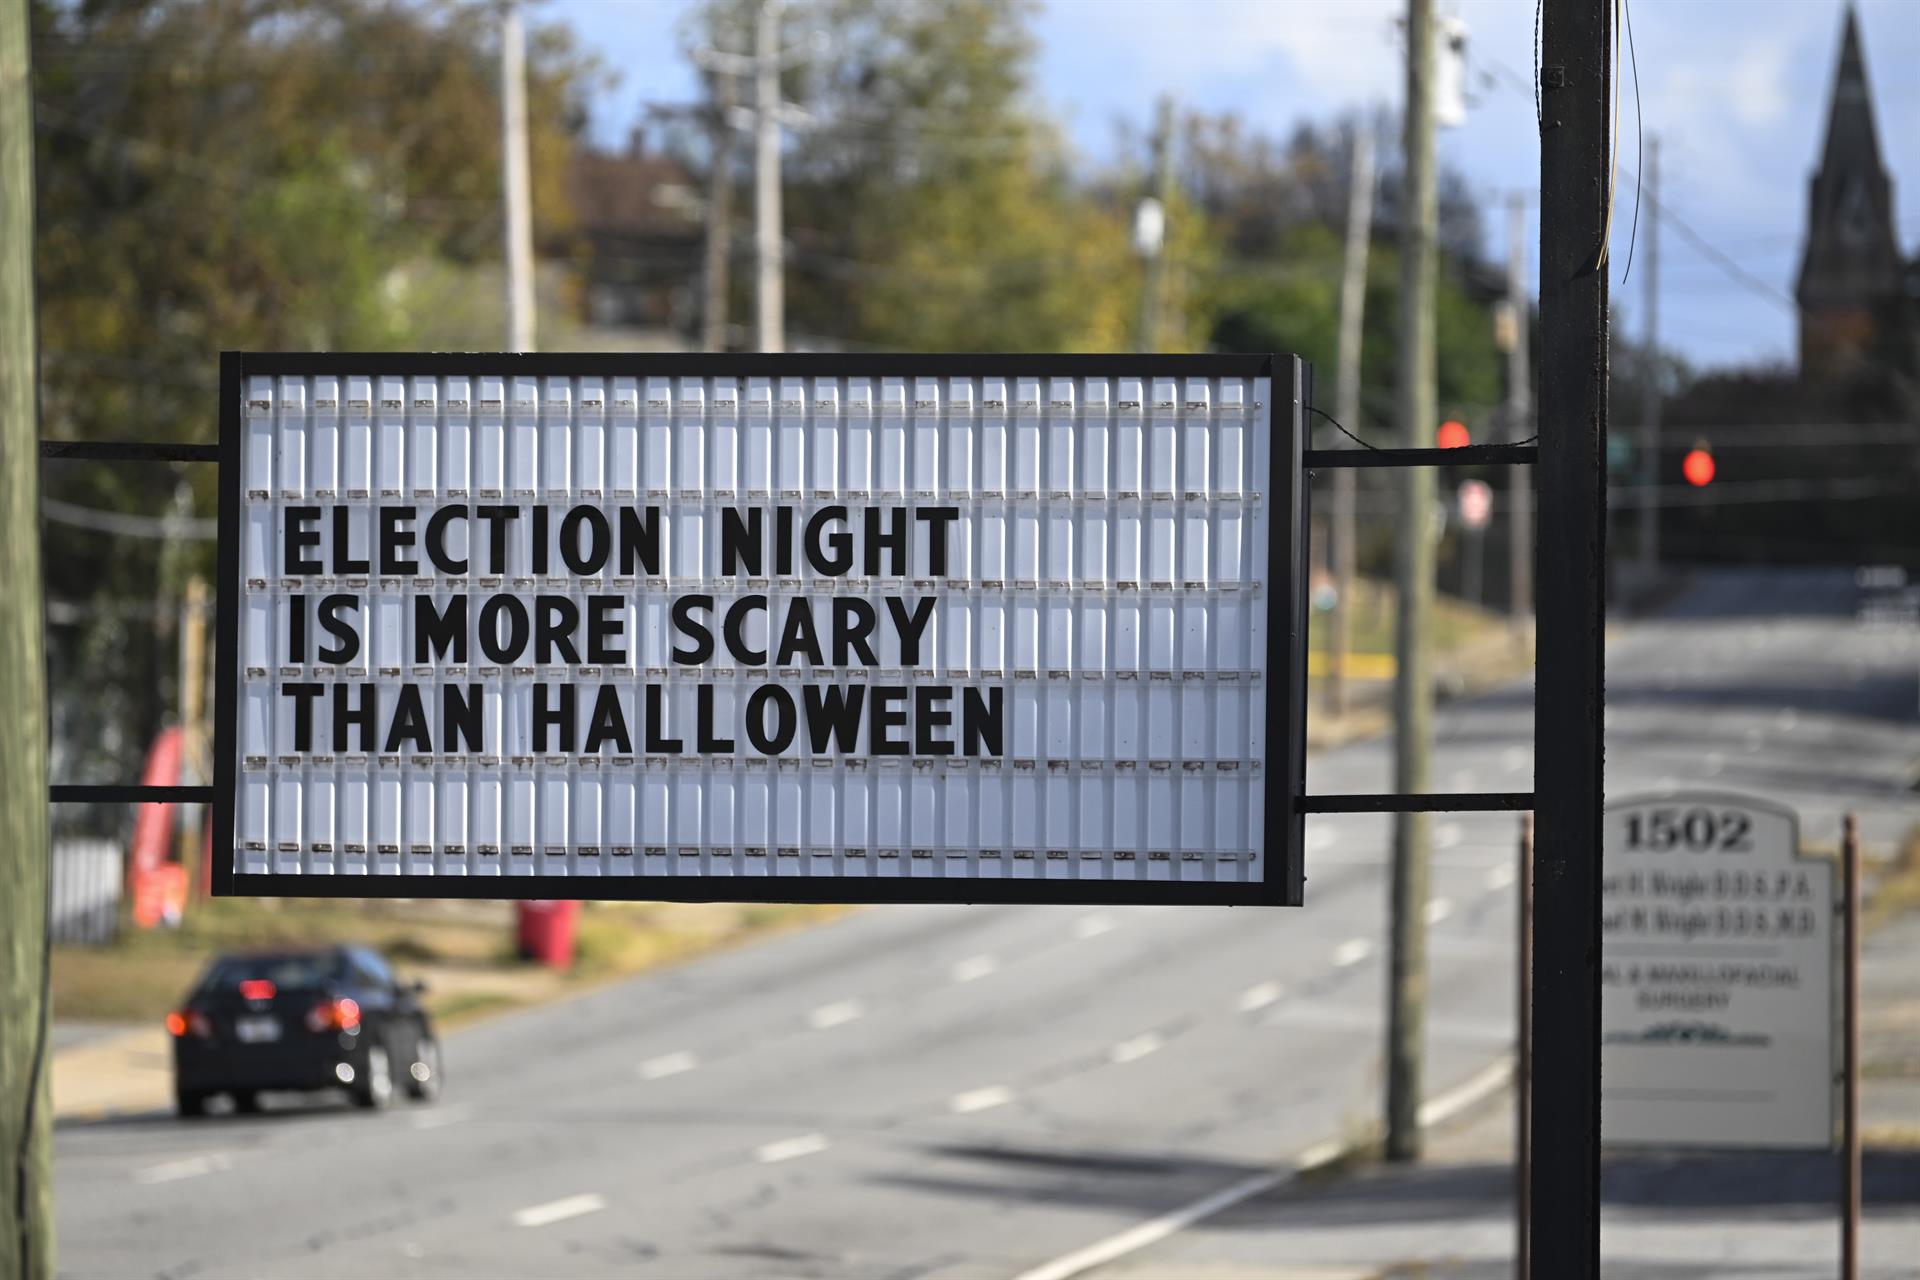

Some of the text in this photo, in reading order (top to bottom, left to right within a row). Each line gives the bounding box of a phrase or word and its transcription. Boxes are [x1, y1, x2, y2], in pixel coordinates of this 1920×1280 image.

[284, 505, 959, 577] ELECTION NIGHT
[289, 593, 937, 667] IS MORE SCARY
[281, 682, 1003, 757] THAN HALLOWEEN
[1624, 808, 1753, 852] 1502
